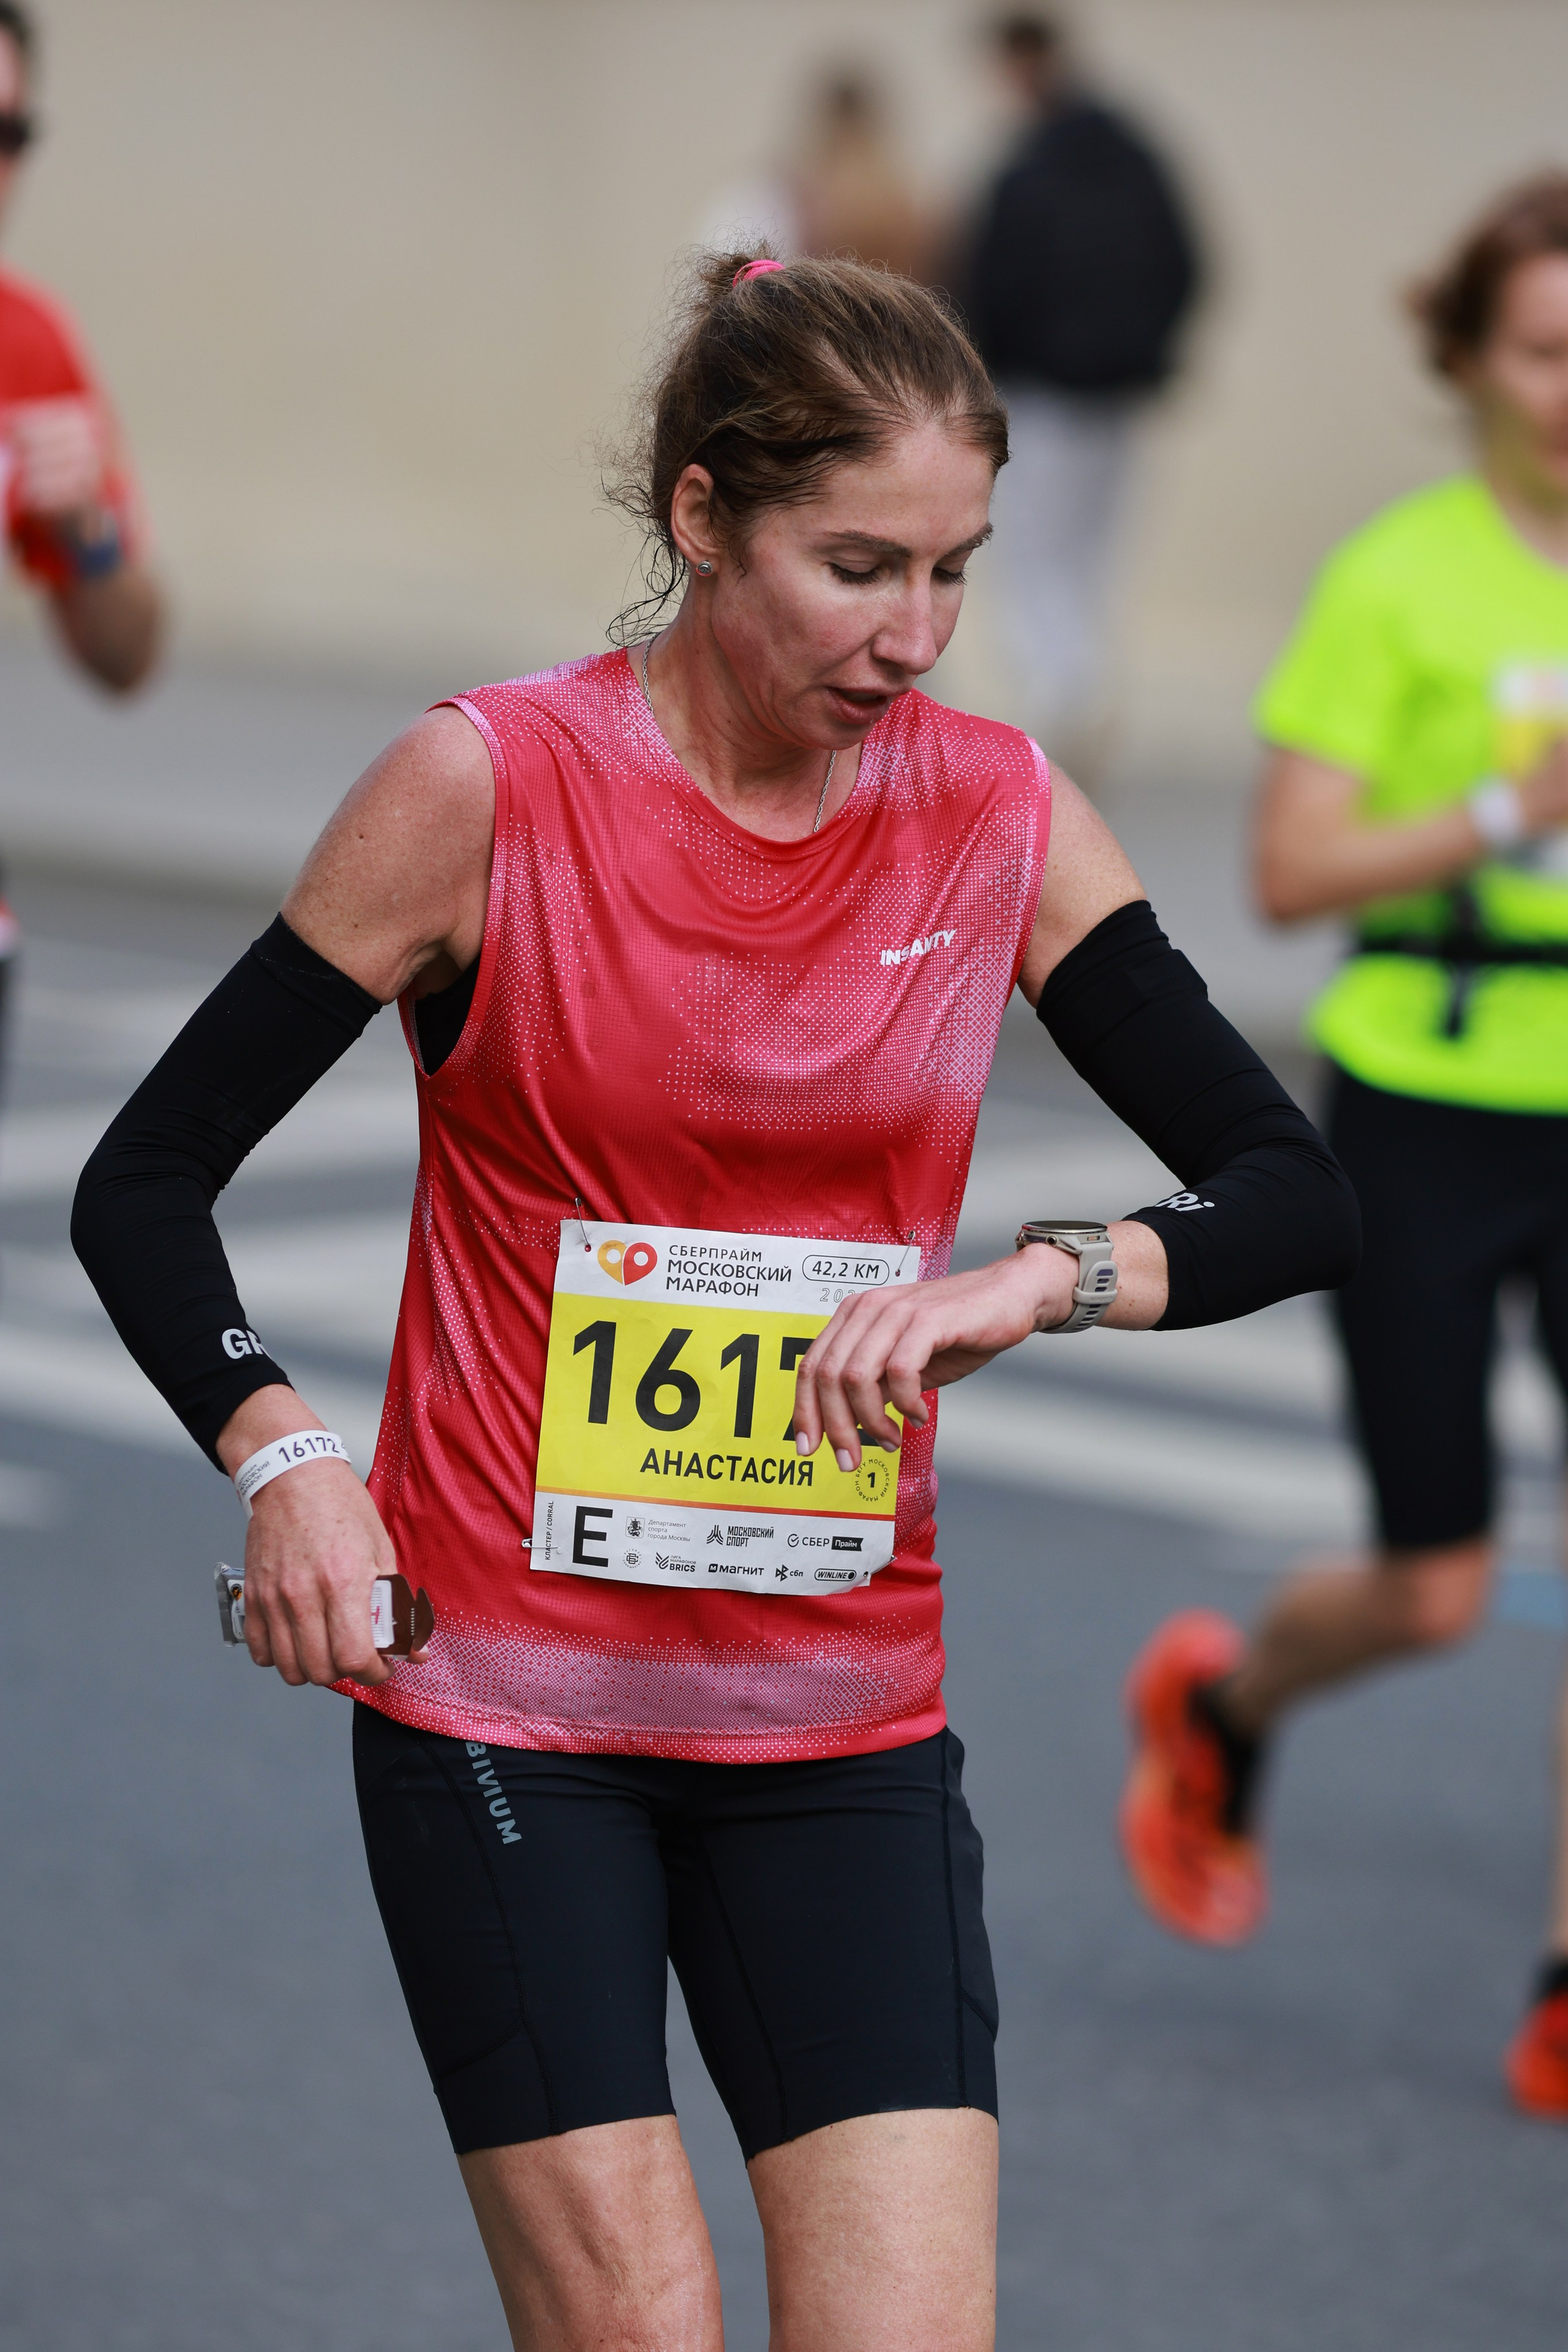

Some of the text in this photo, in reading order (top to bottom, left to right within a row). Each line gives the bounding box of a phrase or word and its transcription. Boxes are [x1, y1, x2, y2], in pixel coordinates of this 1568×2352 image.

[880, 930, 956, 965] INSANTY
[669, 1245, 761, 1262] СБЕРПРАЙМ
[668, 1259, 792, 1282] МОСКОВСКИЙ
[812, 1261, 880, 1279] 42,2 КМ
[666, 1276, 759, 1297] МАРАФОН
[820, 1287, 867, 1303] 20
[573, 1321, 882, 1447] 161
[278, 1437, 340, 1463] 16172
[639, 1448, 814, 1487] АНАСТАСИЯ
[855, 1462, 865, 1477] БЕГУ
[869, 1459, 889, 1497] МОСКОВСКИЙ
[867, 1472, 875, 1488] 1
[726, 1536, 749, 1547] СПОРТ
[728, 1526, 774, 1539] МОСКОВСКИЙ
[802, 1537, 858, 1548] СБЕР Прайм
[669, 1563, 696, 1572] BRICS
